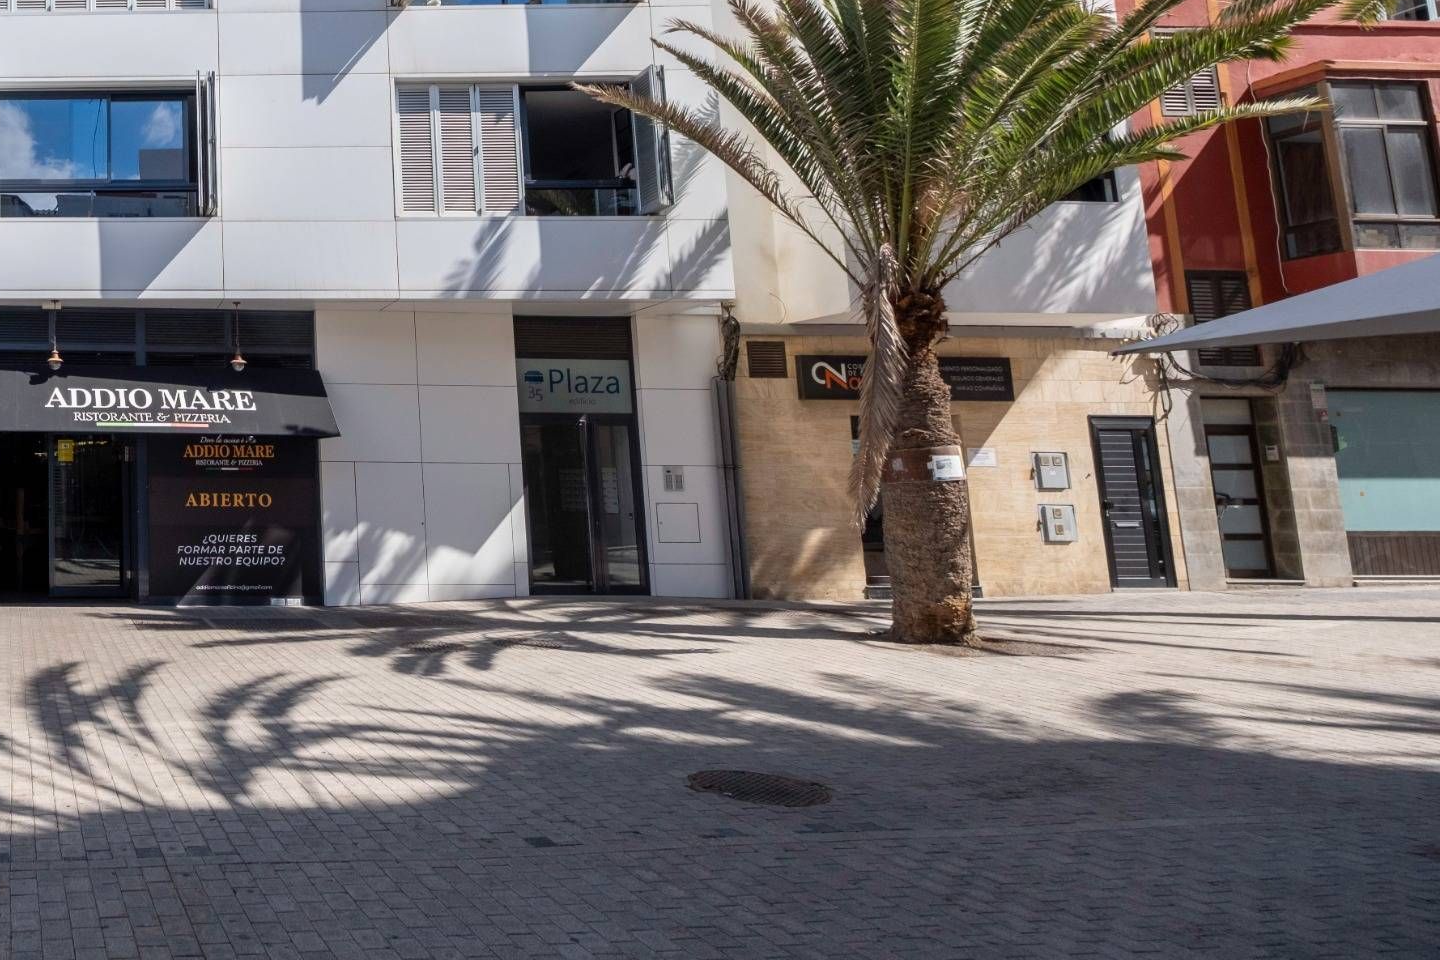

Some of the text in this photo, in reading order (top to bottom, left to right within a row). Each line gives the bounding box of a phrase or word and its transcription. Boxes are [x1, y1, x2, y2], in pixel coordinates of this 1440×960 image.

[549, 368, 620, 394] Plaza
[45, 387, 257, 411] ADDIO MARE
[528, 386, 543, 402] 35
[73, 411, 231, 423] RISTORANTE & PIZZERIA
[184, 444, 275, 458] ADDIO MARE
[185, 492, 272, 507] ABIERTO
[202, 534, 257, 544] ¿QUIERES
[177, 545, 284, 554] FORMAR PARTE DE
[179, 556, 286, 567] NUESTRO EQUIPO?
